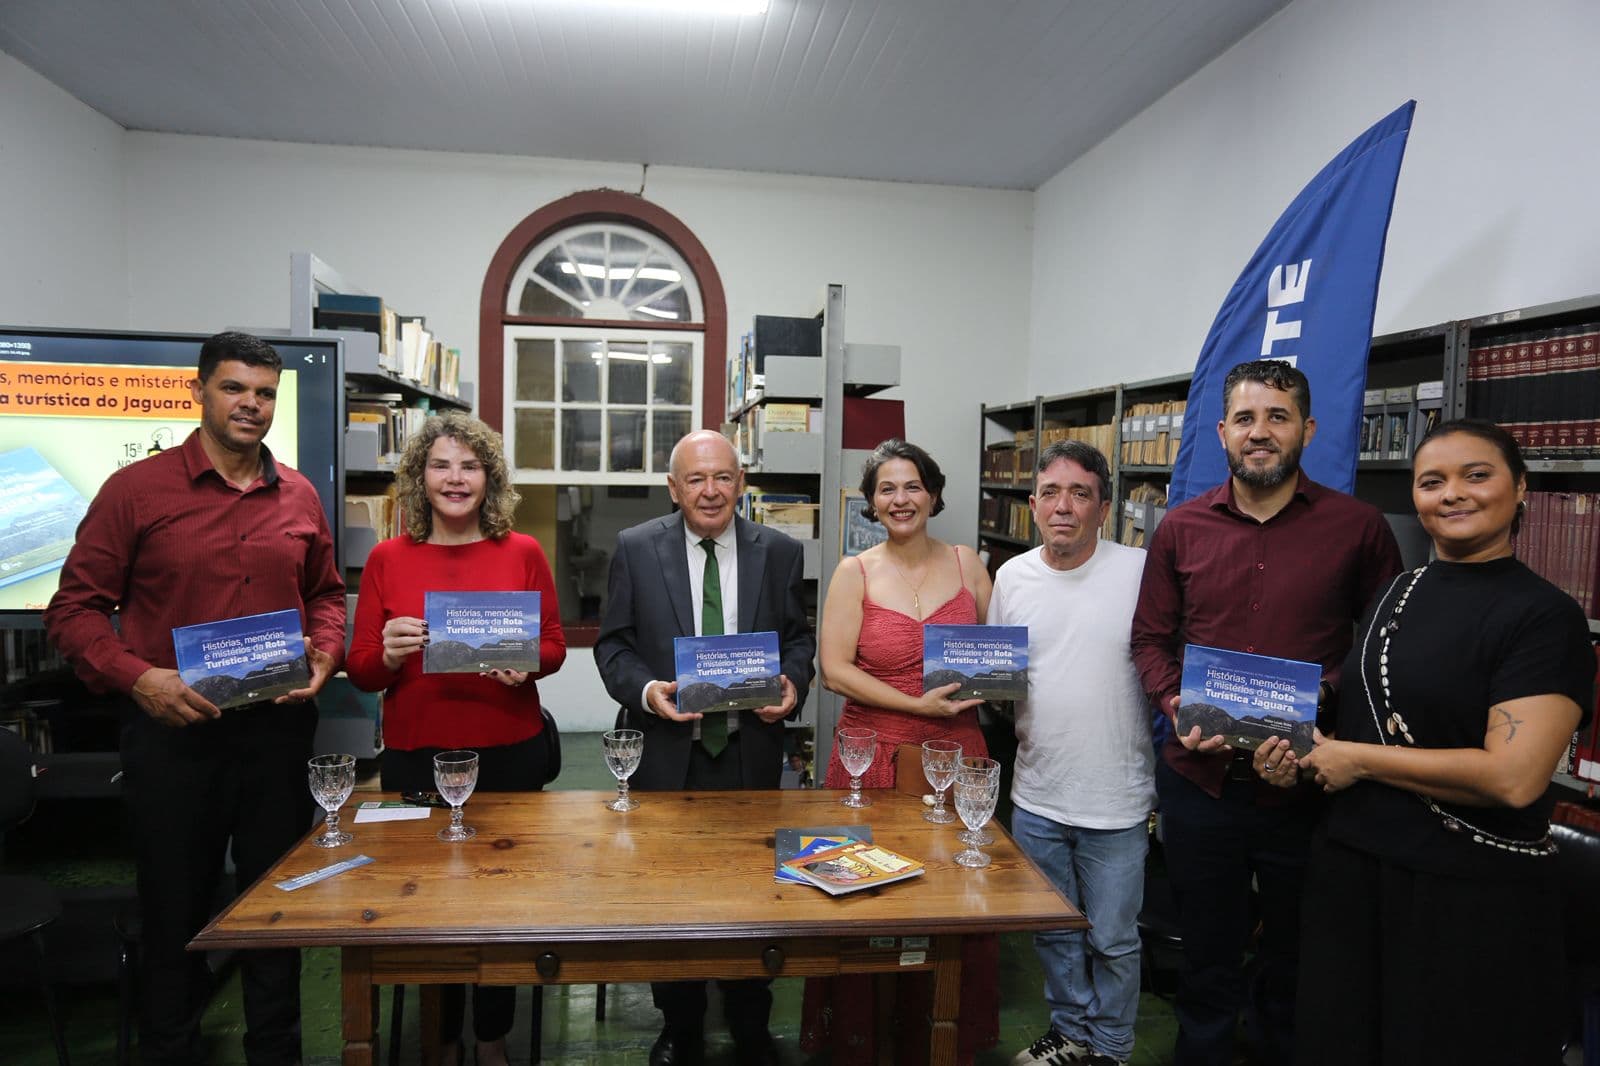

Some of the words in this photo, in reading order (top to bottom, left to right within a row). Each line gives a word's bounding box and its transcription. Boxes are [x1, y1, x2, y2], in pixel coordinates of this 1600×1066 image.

[1259, 258, 1313, 368] TE
[18, 372, 104, 387] memórias
[110, 377, 119, 387] e
[16, 393, 90, 407] turística
[96, 395, 118, 408] do
[123, 396, 192, 413] Jaguara
[446, 609, 483, 618] Histórias,
[485, 609, 523, 617] memórias
[454, 618, 489, 626] mistérios
[491, 618, 501, 626] da
[446, 626, 485, 634] Turística
[488, 626, 523, 635] Jaguara
[202, 639, 243, 652] Histórias,
[244, 631, 285, 643] memórias
[943, 641, 976, 650] Histórias,
[978, 642, 1012, 650] memórias
[212, 646, 251, 658] mistérios
[253, 643, 264, 652] da
[265, 640, 286, 649] Rota
[696, 652, 729, 661] Histórias,
[730, 649, 764, 658] memórias
[950, 649, 982, 657] mistérios
[205, 655, 249, 669] Turística
[250, 648, 288, 661] Jaguara
[703, 660, 735, 668] mistérios
[943, 657, 978, 665] Turística
[980, 657, 1013, 666] Jaguara
[697, 667, 732, 676] Turística
[734, 666, 766, 675] Jaguara
[1207, 669, 1248, 685] Histórias,
[1250, 678, 1296, 693] memórias
[1214, 681, 1255, 695] mistérios
[1257, 689, 1269, 698] da
[1271, 690, 1296, 702] Rota
[1205, 688, 1249, 704] Turística
[1251, 698, 1294, 712] Jaguara
